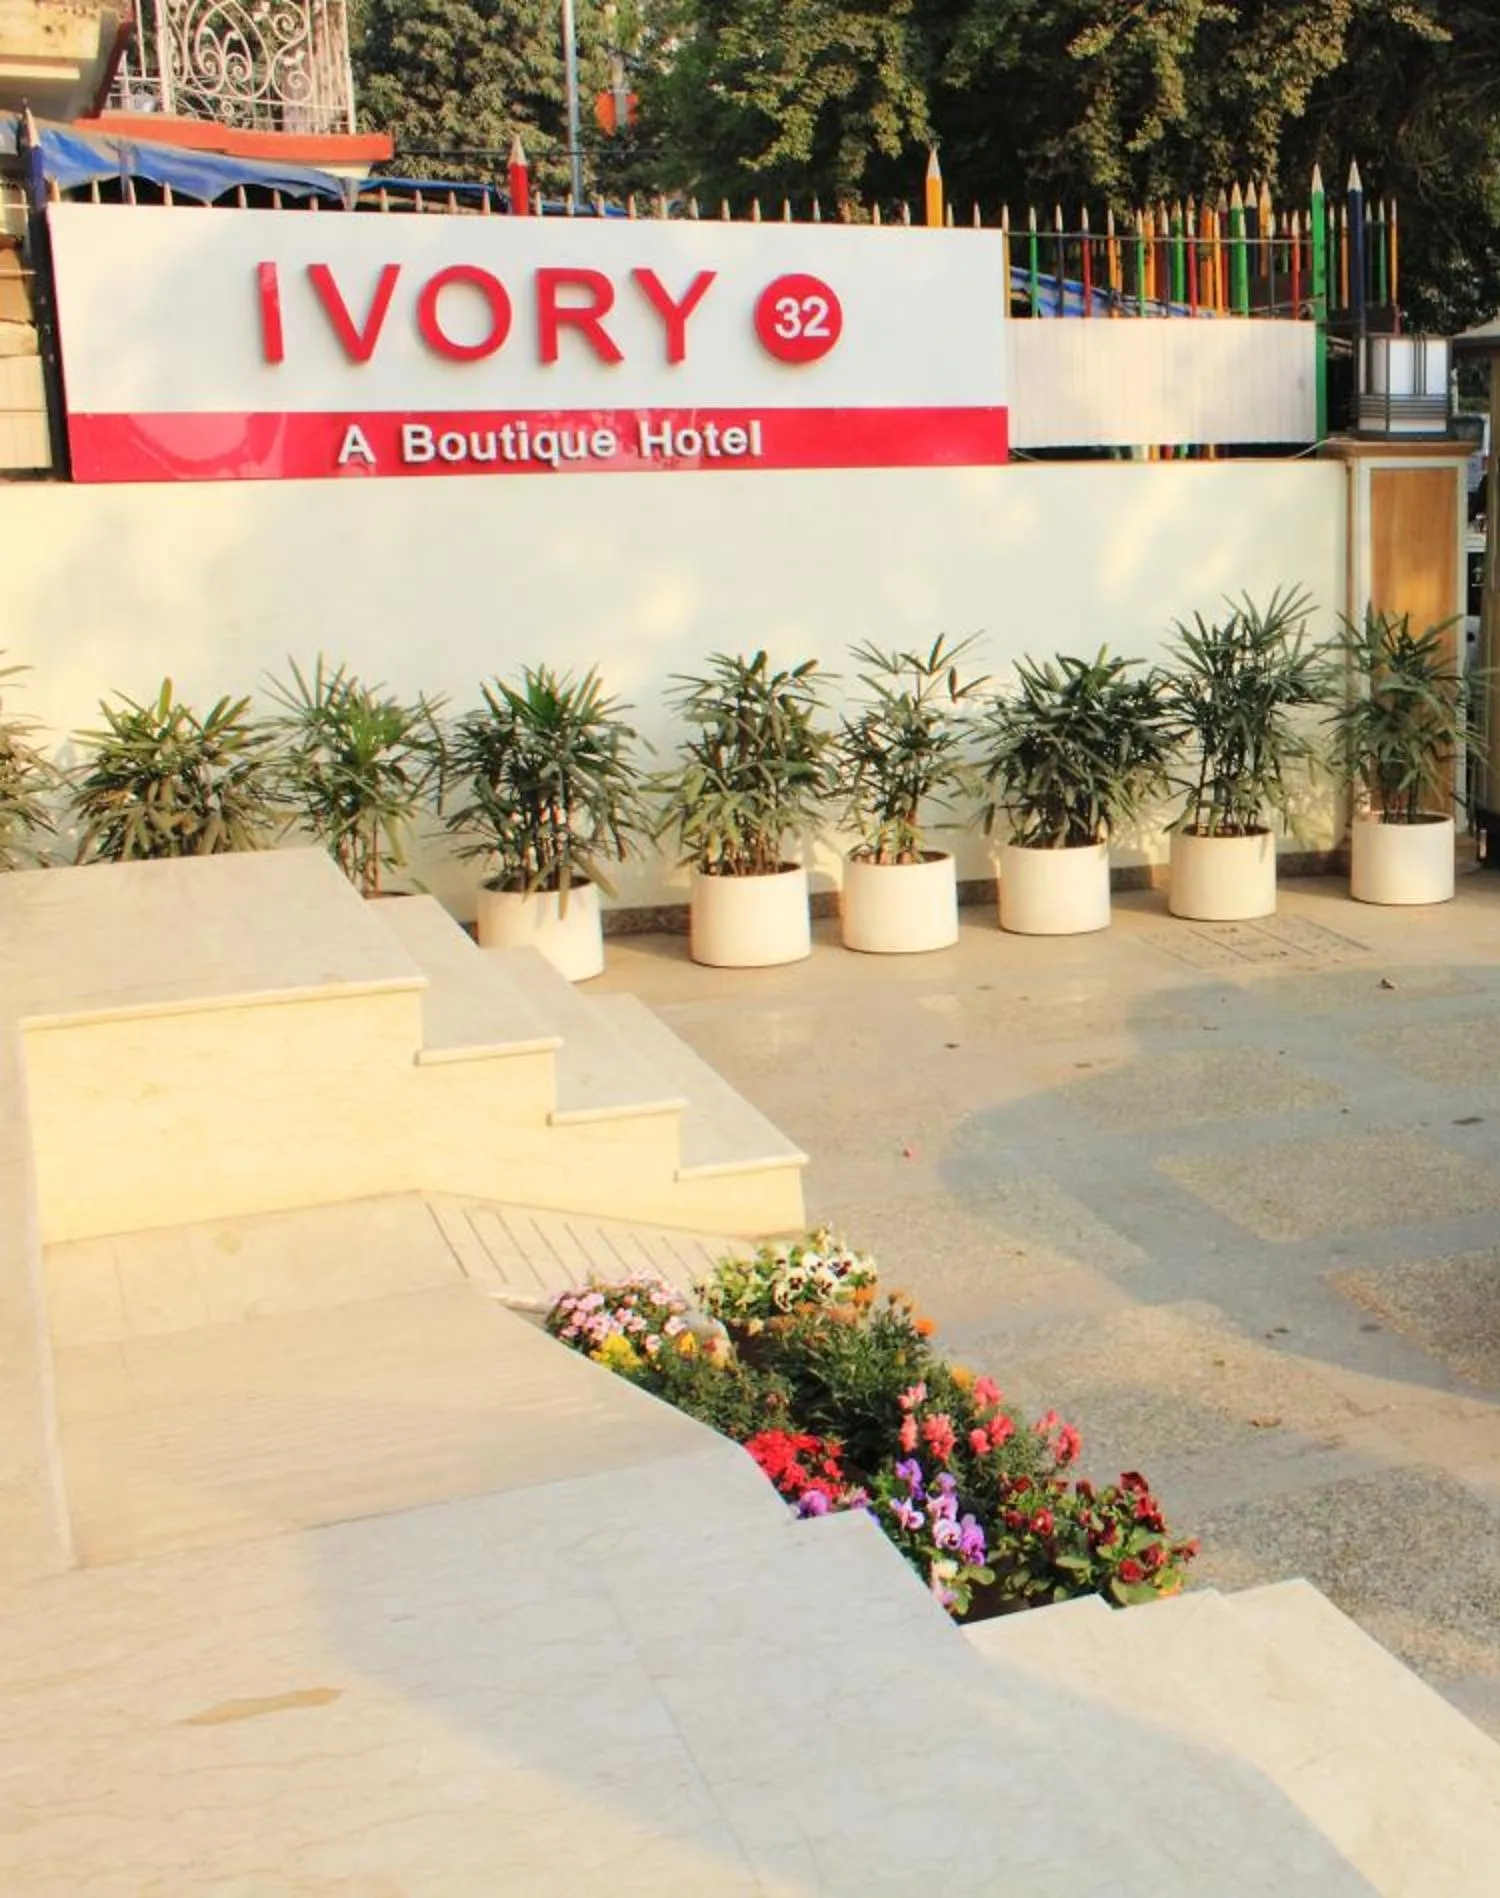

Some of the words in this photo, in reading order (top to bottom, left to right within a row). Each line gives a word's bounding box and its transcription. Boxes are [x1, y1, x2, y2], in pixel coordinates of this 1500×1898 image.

[257, 261, 717, 366] IVORY
[774, 294, 831, 340] 32
[337, 423, 377, 465] A
[402, 421, 617, 468] Boutique
[639, 419, 763, 458] Hotel
